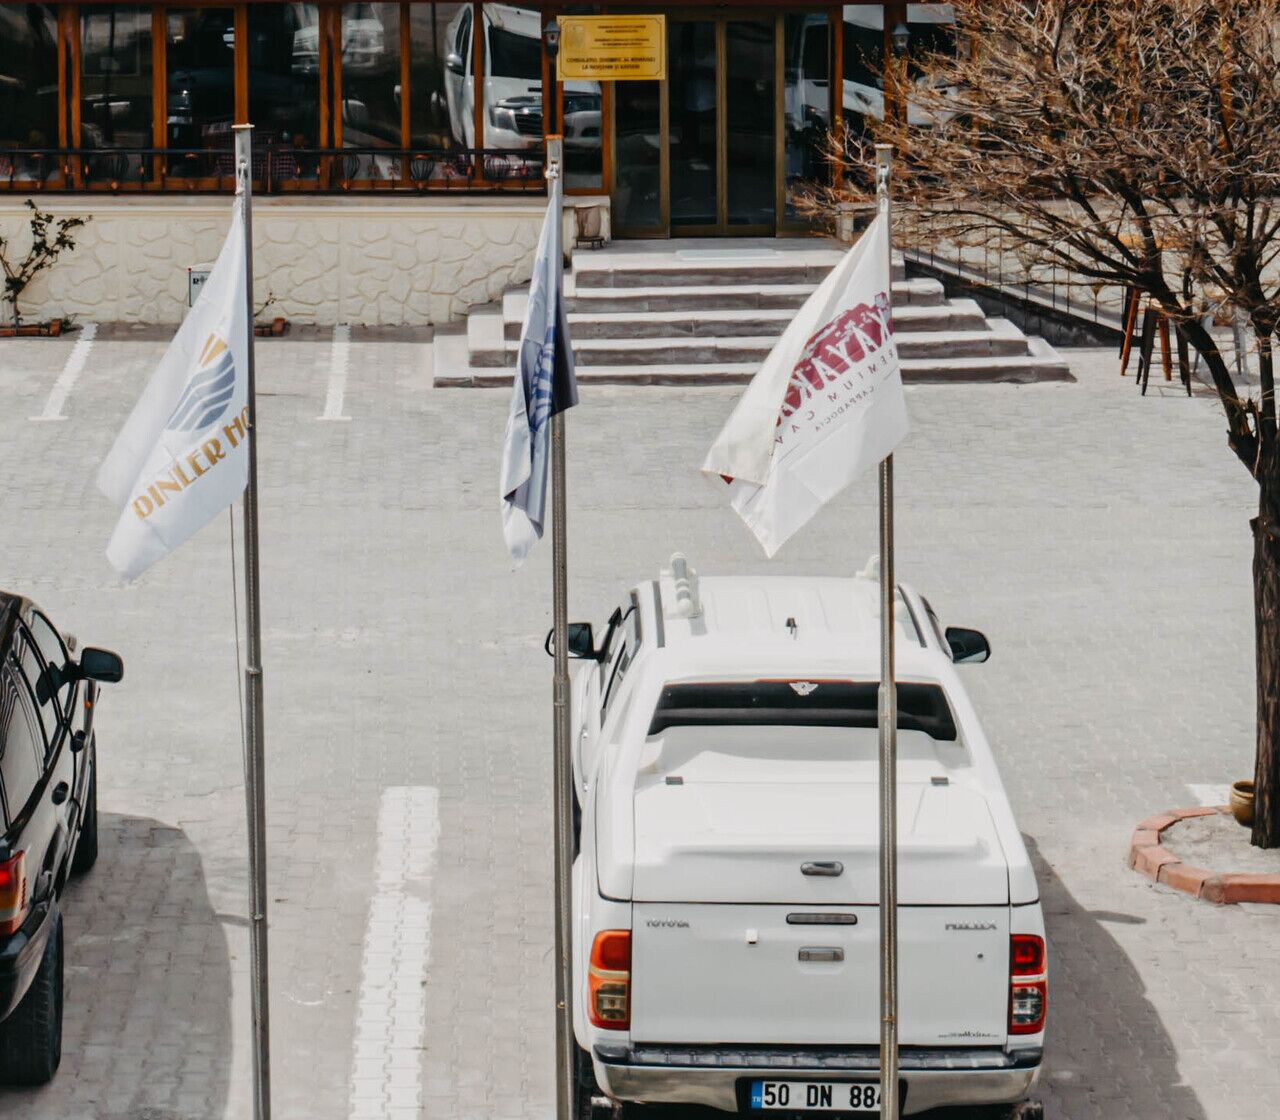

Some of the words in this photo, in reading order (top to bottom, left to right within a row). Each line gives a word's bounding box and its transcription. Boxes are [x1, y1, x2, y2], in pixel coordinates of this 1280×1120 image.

[132, 437, 226, 521] DINLER
[764, 1083, 790, 1107] 50
[806, 1084, 833, 1108] DN
